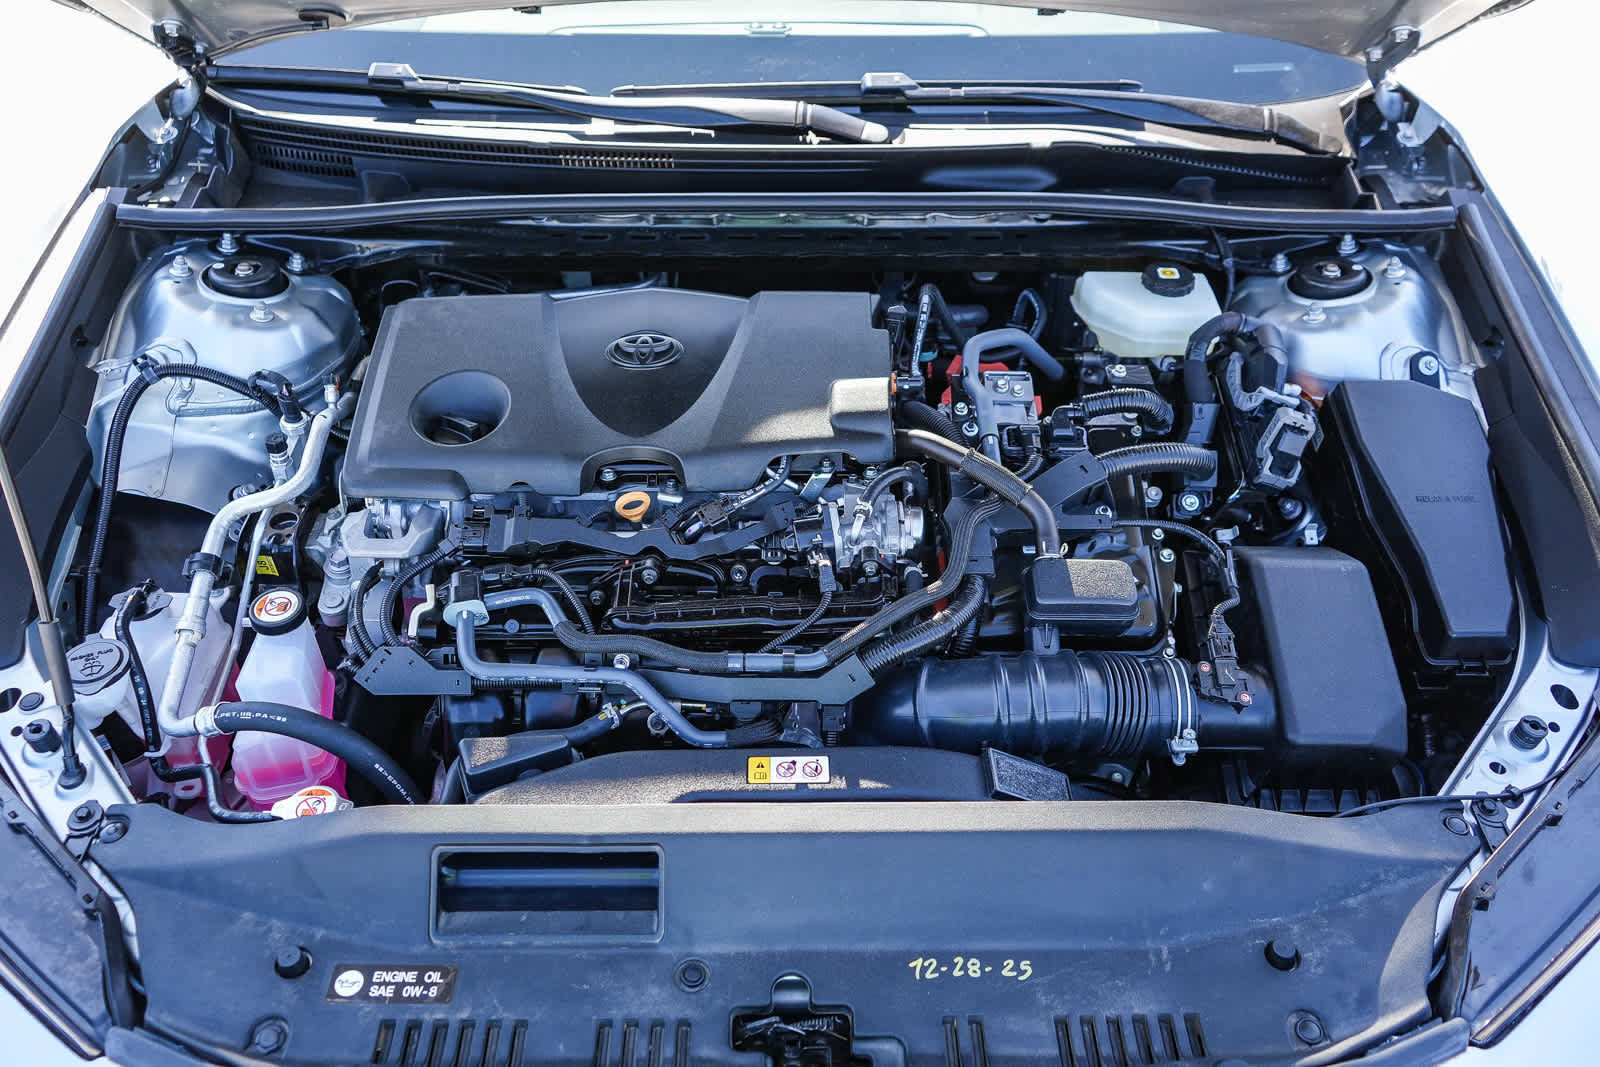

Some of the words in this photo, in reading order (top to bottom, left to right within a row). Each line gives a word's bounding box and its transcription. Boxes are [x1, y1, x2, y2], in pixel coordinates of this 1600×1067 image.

[372, 971, 418, 983] ENGINE
[424, 971, 444, 983] OIL
[368, 985, 396, 997] SAE
[402, 985, 438, 998] 0W-8
